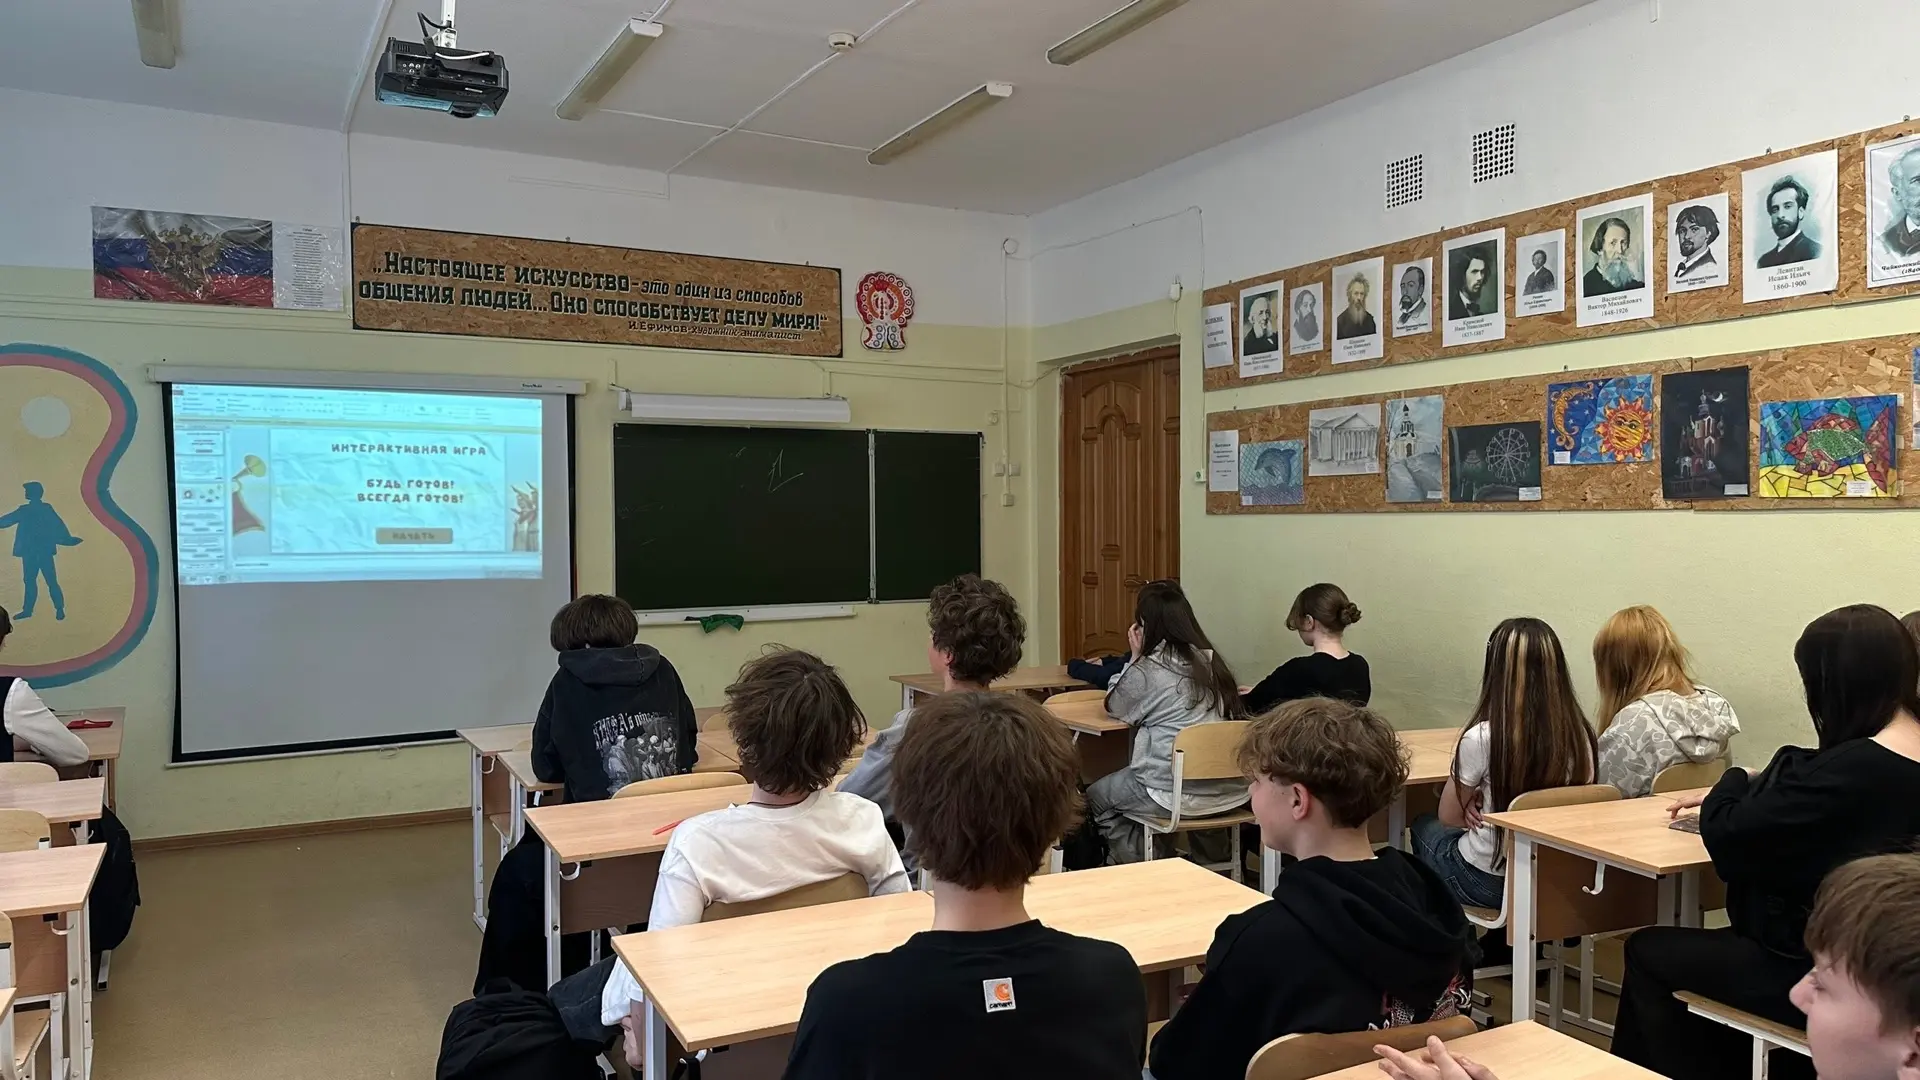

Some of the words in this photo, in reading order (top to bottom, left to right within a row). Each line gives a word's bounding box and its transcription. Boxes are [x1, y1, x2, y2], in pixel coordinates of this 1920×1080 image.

[674, 282, 710, 300] один
[714, 287, 731, 300] из
[736, 290, 803, 307] способов
[358, 281, 455, 305] ОБЩЕНИЯ
[593, 299, 720, 324] СПОСОБСТВУЕТ
[724, 309, 768, 327] ДЕЛУ
[331, 443, 447, 455] ИНТЕРАКТИВНАЯ
[453, 447, 487, 456] ИГРА
[366, 479, 401, 489] БУДЬ
[407, 480, 455, 490] ГОТОВ!
[357, 493, 410, 503] ВСЕГДА
[416, 494, 464, 504] ГОТОВ!
